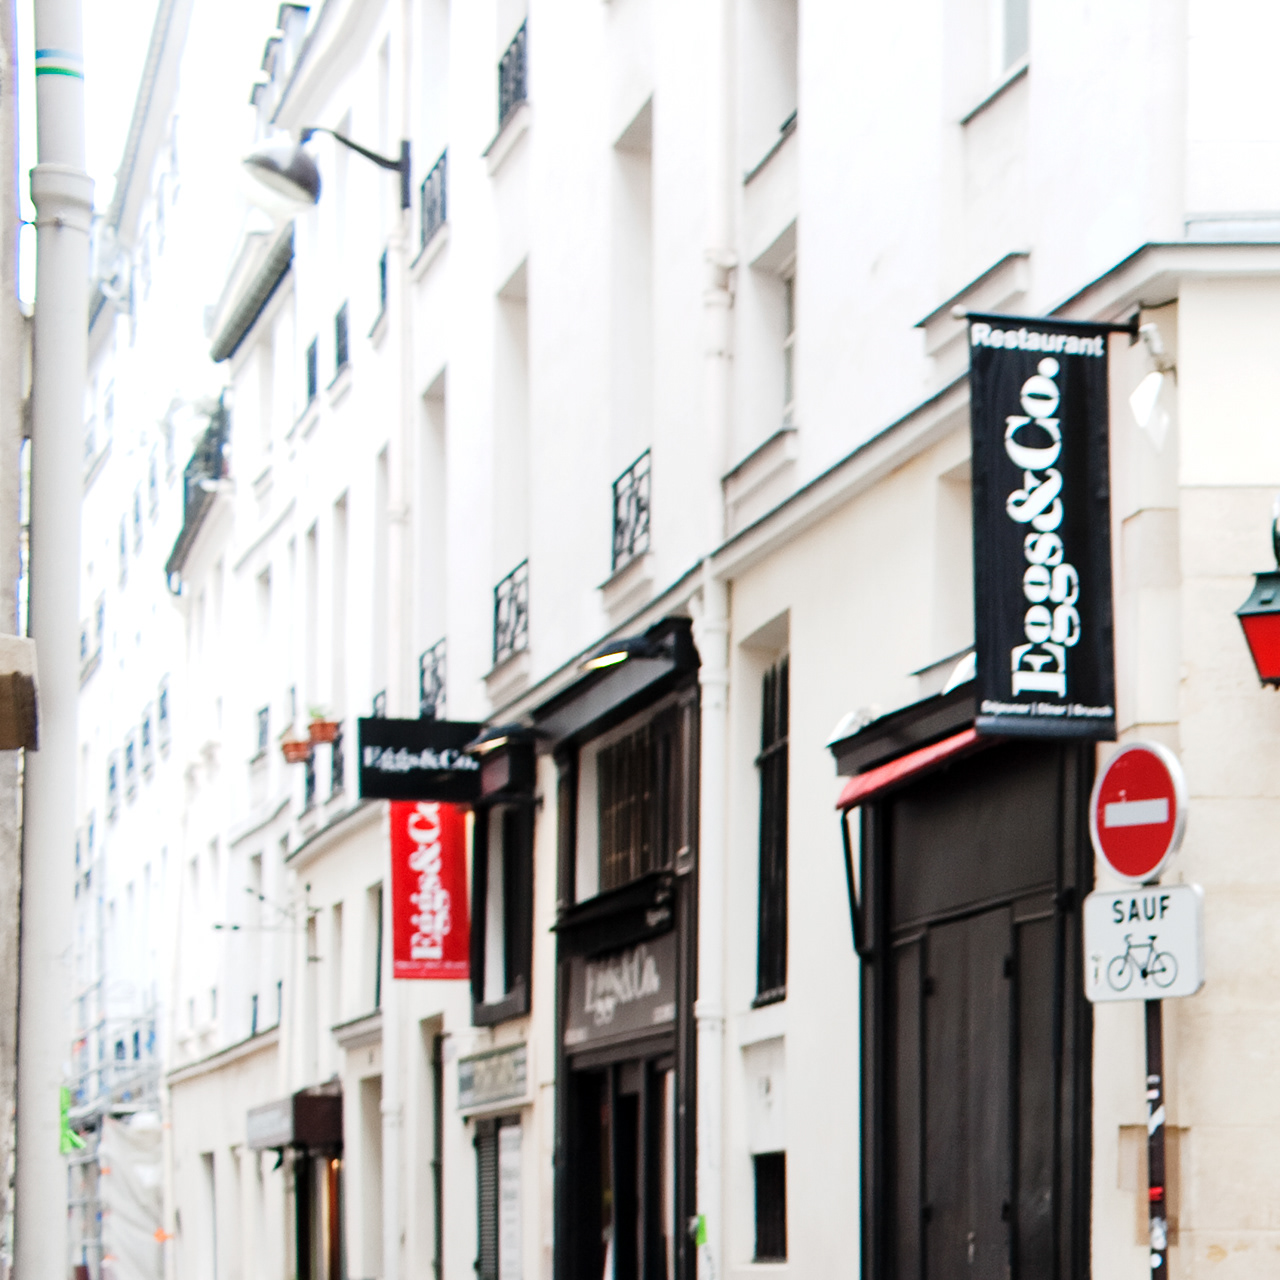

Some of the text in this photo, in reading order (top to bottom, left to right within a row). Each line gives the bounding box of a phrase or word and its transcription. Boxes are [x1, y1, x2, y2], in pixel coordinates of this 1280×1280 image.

[971, 322, 1104, 357] Restaurant
[1004, 356, 1082, 699] Eggs&Co.
[1112, 895, 1170, 923] SAUF
